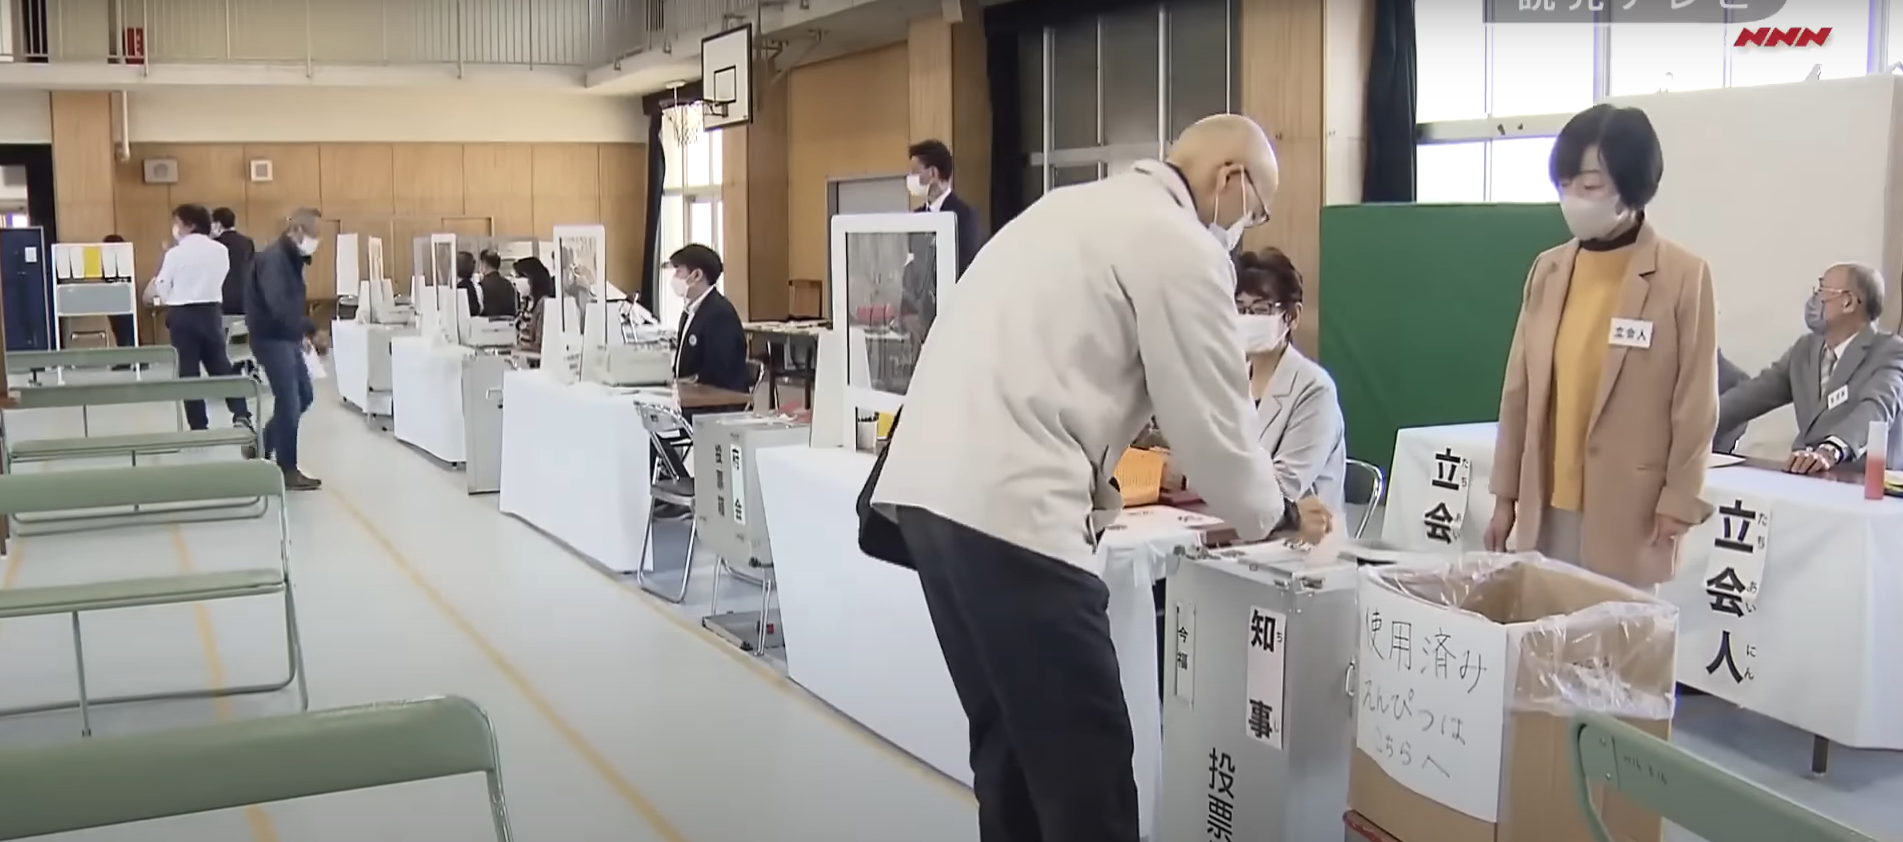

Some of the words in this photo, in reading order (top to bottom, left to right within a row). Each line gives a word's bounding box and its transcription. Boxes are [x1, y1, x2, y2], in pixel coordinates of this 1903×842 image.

[1614, 326, 1646, 341] 立会人
[1424, 448, 1461, 545] 立会
[1705, 499, 1756, 684] 立会人
[1177, 626, 1189, 670] 今福
[1248, 609, 1276, 739] 知事
[1365, 607, 1487, 694] 使用済み
[1363, 680, 1466, 746] えんぴつは
[1375, 725, 1450, 779] こちらへ
